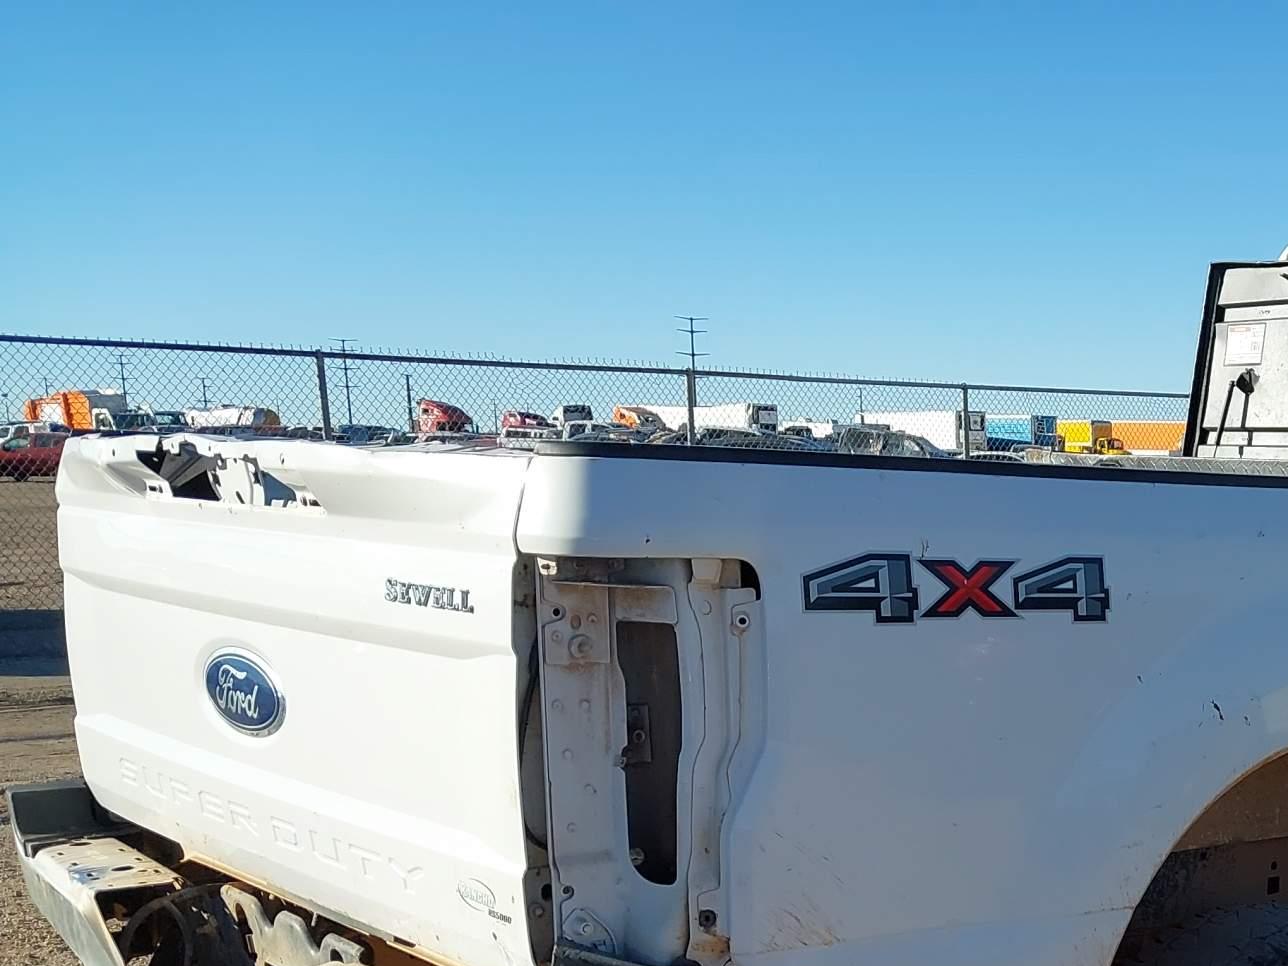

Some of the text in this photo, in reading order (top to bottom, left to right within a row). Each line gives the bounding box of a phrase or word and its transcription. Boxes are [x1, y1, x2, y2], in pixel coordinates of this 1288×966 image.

[384, 576, 475, 615] SEWELL
[215, 663, 259, 720] Ford
[119, 756, 424, 896] SUPER DUTY
